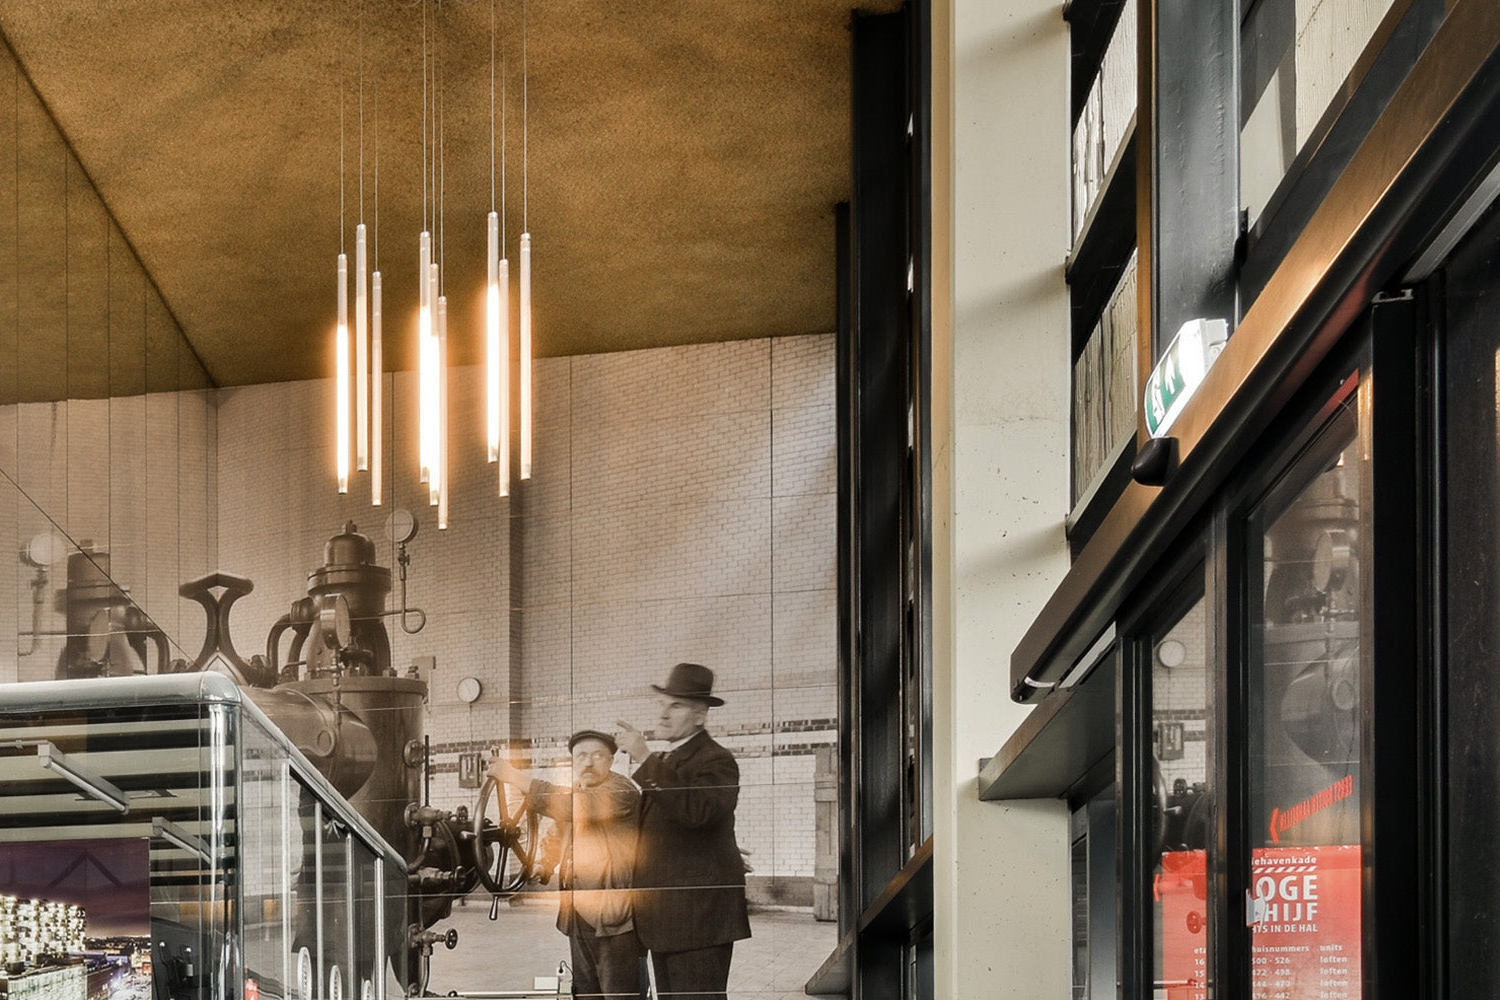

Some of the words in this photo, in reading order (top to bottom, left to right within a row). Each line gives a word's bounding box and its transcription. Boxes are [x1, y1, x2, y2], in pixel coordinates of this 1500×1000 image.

[1270, 925, 1282, 933] IN
[1284, 925, 1297, 933] DE
[1299, 923, 1318, 932] HAL
[1320, 944, 1343, 952] units
